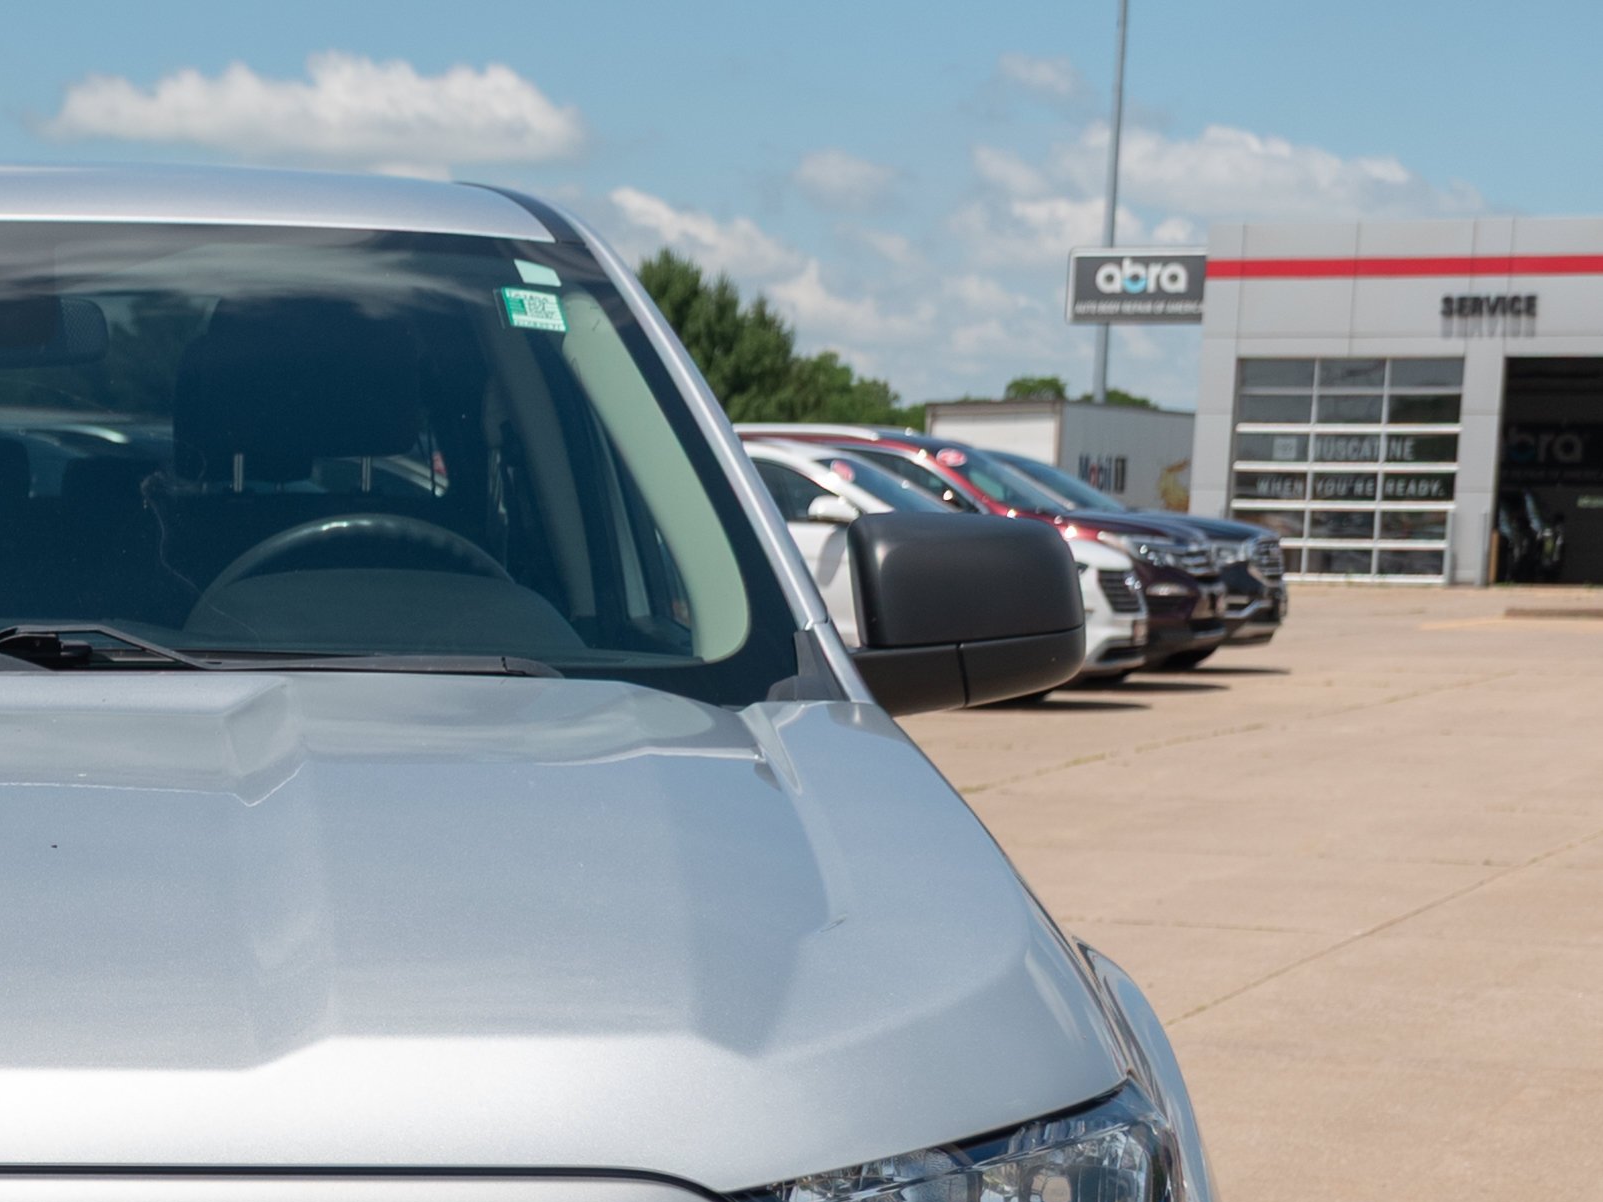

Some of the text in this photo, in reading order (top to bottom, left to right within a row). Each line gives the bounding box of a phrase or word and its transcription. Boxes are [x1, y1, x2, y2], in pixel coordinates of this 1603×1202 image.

[1095, 257, 1188, 294] abra
[1441, 294, 1537, 316] SERVICE
[1314, 437, 1415, 461] USCATNE
